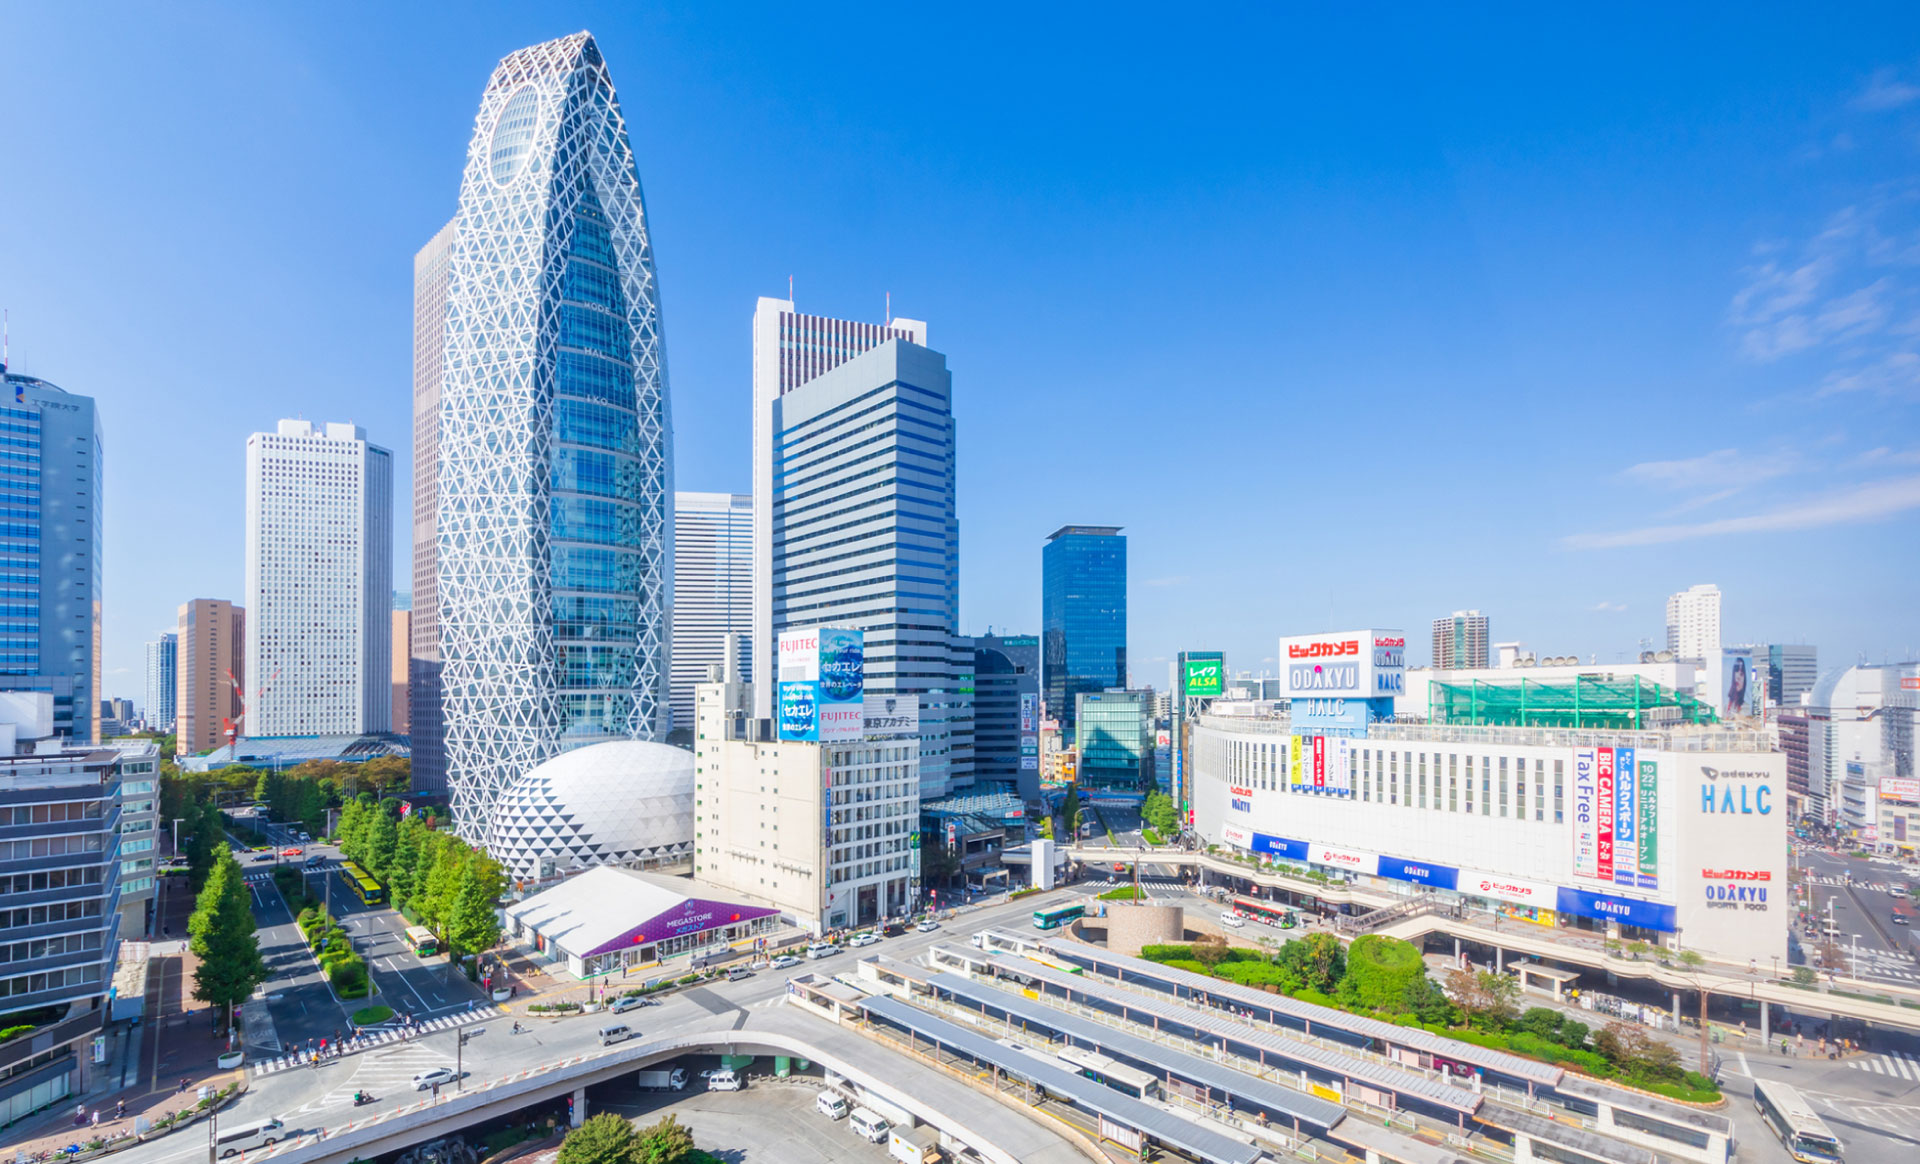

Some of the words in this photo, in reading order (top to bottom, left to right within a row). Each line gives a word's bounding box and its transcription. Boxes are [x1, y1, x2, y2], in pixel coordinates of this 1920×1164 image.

[780, 637, 818, 654] FUJITEC
[1289, 640, 1359, 658] ビックカメラ
[1374, 638, 1404, 647] ビックカメラ
[1190, 667, 1216, 677] レイク
[1292, 665, 1355, 688] ODAKYU
[1189, 677, 1216, 686] ALSA
[1377, 673, 1401, 690] HALC
[1308, 698, 1345, 716] HALC
[820, 711, 862, 723] FUJITEC
[863, 717, 917, 730] 東京アカデミー
[1578, 751, 1594, 782] Tax
[1599, 753, 1611, 774] BIC
[1721, 770, 1770, 779] odakyu
[1578, 785, 1594, 823] Free
[1599, 777, 1611, 834] CAMERA
[1619, 770, 1631, 839] ハルクスポーツ
[1701, 784, 1772, 815] HALC
[1640, 790, 1648, 861] リニューアルオープン
[1404, 866, 1429, 878] ODAKYU
[1702, 868, 1771, 881] ビックカメラ
[1492, 882, 1532, 895] ビックカメラ
[1706, 884, 1767, 902] ODAKYU
[1594, 901, 1630, 915] ODAKYU
[1706, 901, 1738, 910] SPORTS
[1744, 903, 1767, 911] FOOD
[667, 912, 712, 928] MEGASTORE
[675, 922, 705, 934] メガストア
